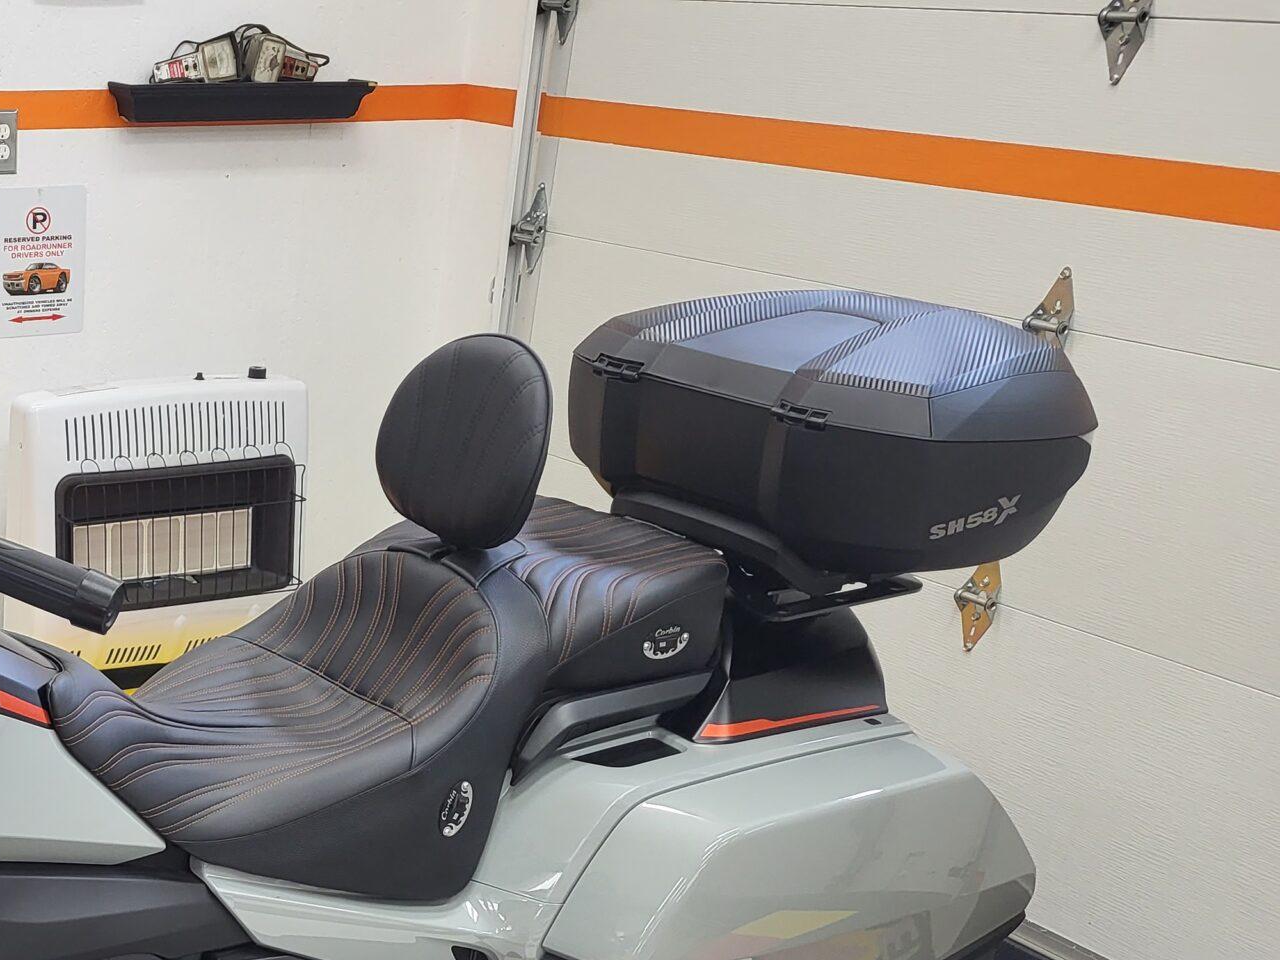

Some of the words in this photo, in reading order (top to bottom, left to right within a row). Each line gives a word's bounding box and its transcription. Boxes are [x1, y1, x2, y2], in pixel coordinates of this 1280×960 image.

[21, 243, 73, 251] ROADRUNNER
[11, 251, 44, 259] DRIVERS
[928, 494, 1022, 541] SH58X
[655, 625, 681, 638] Corbin
